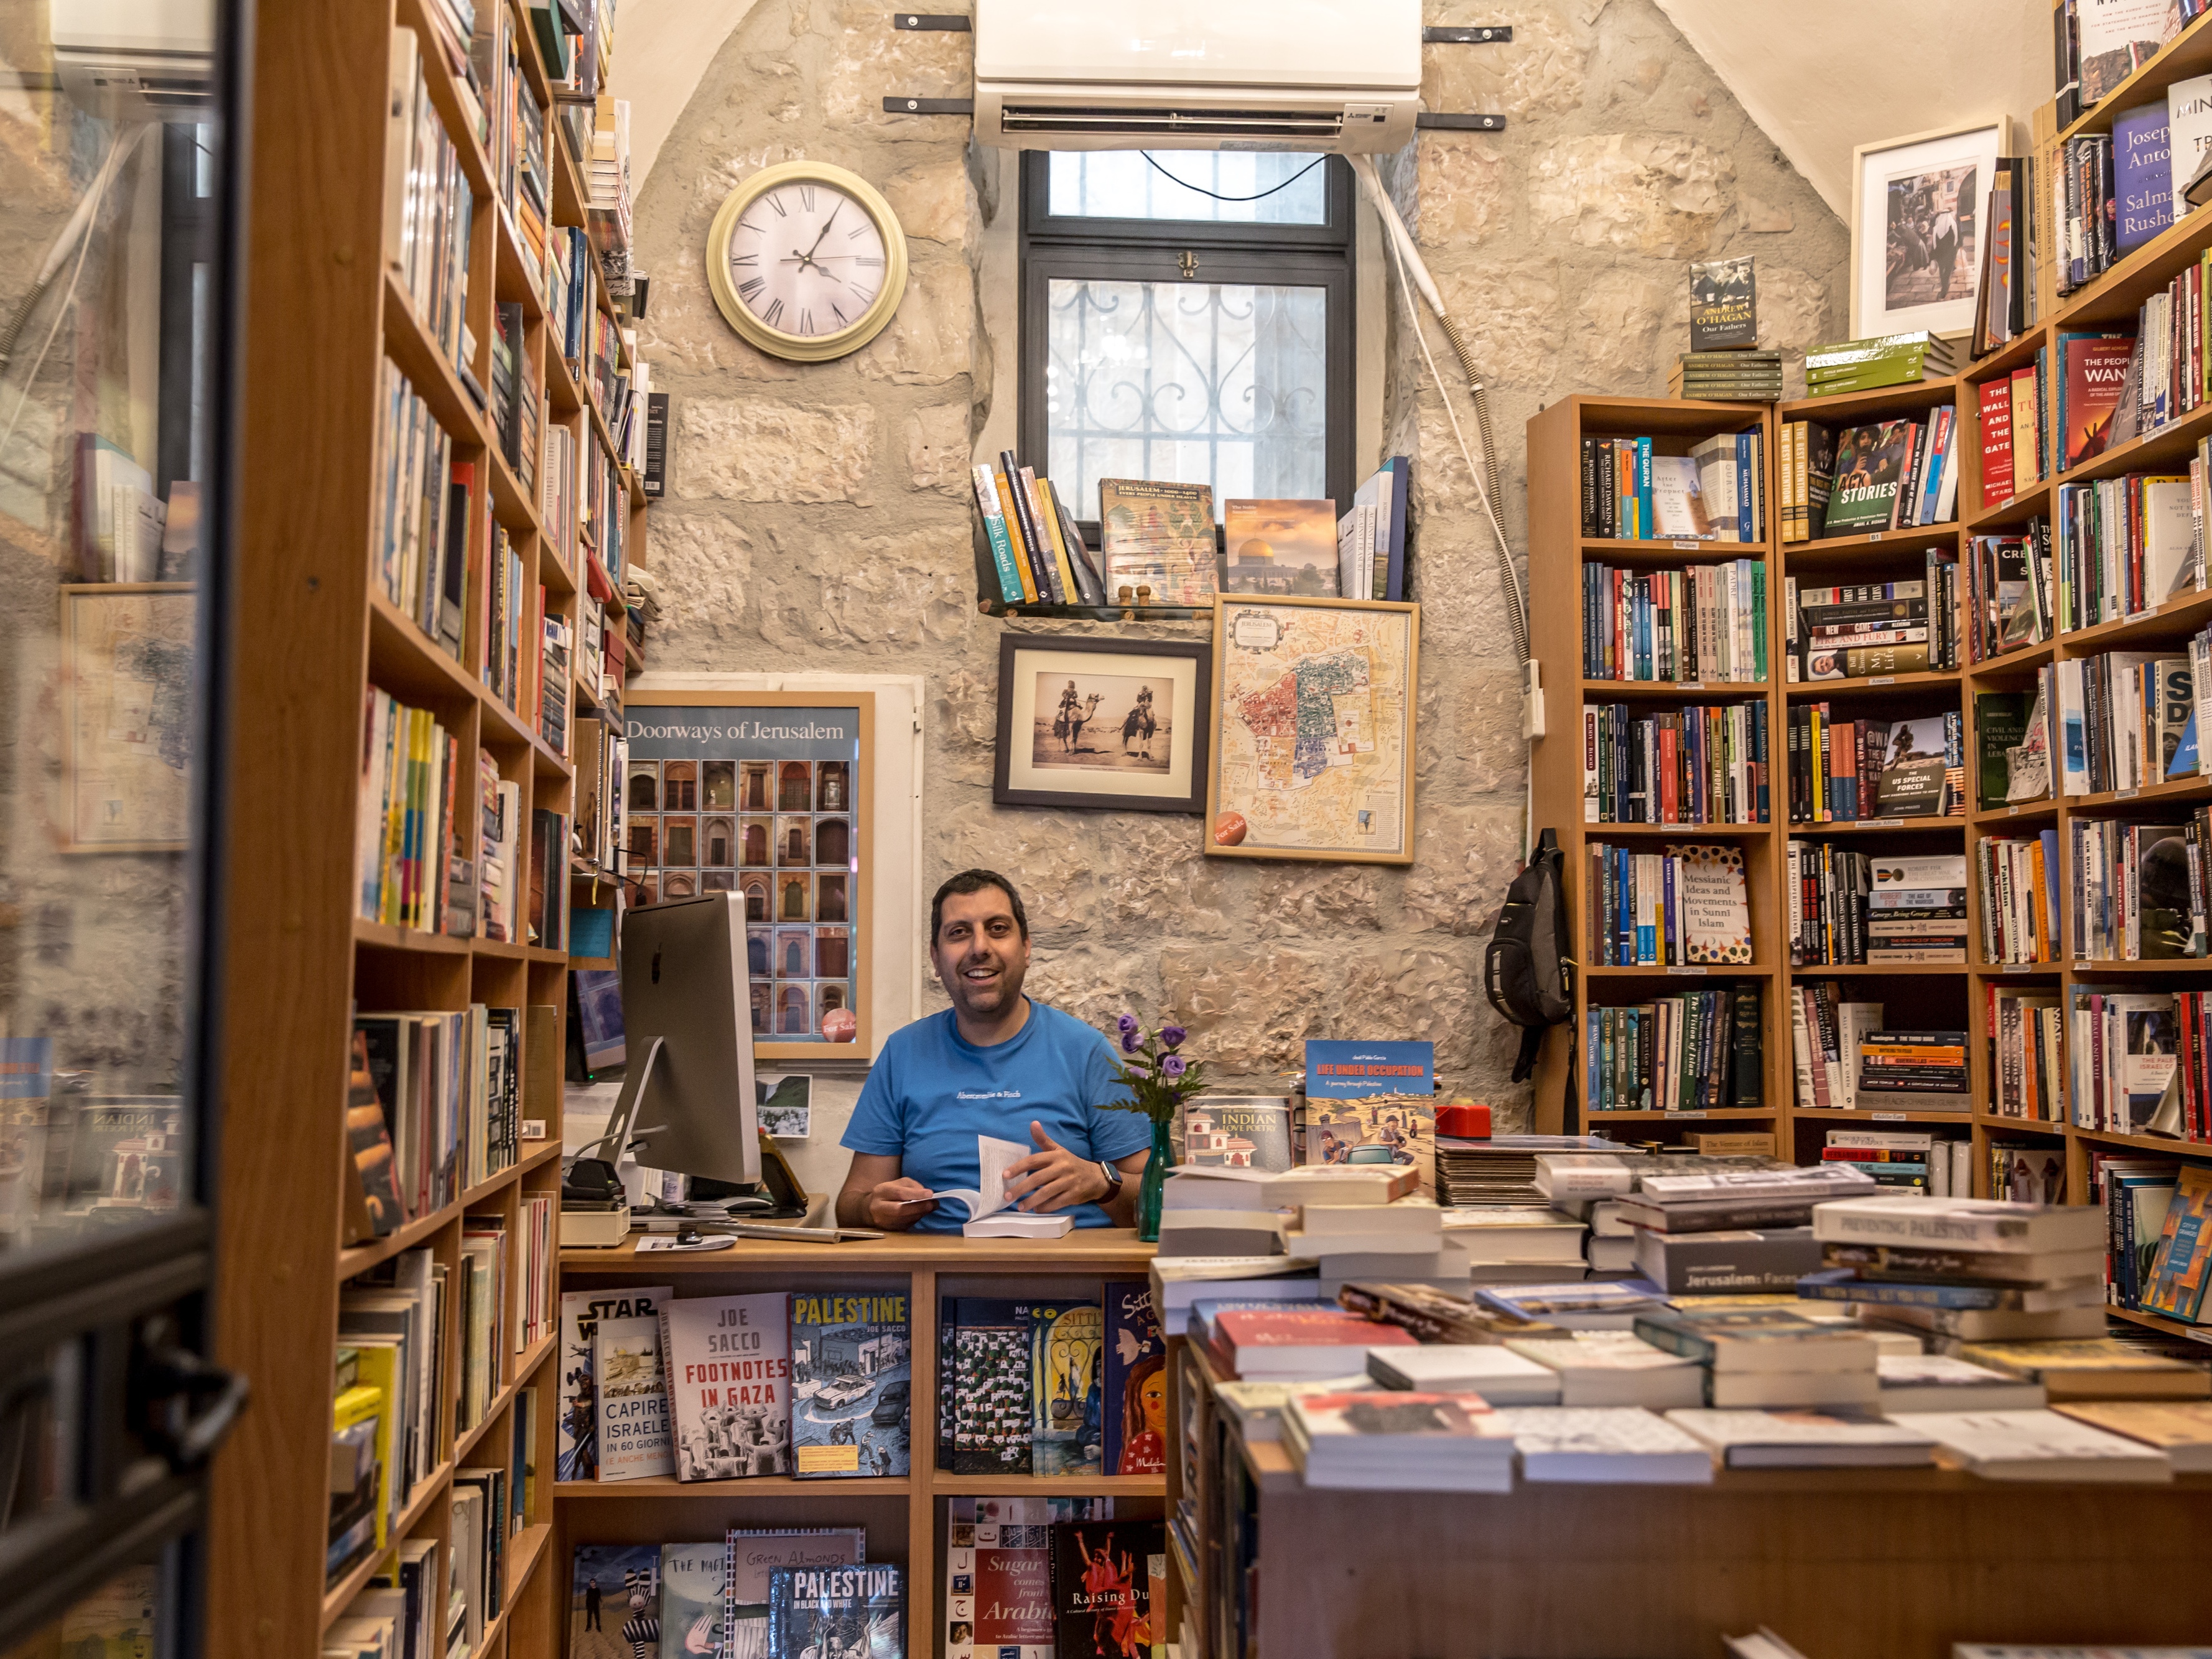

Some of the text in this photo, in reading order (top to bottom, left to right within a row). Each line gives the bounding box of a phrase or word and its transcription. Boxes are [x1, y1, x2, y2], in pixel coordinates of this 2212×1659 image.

[2127, 126, 2171, 152] Josep
[2128, 149, 2171, 170] Anto
[2126, 188, 2173, 213] Salma
[2124, 211, 2175, 235] Rush
[1696, 310, 1752, 326] O'HAGAN
[1703, 304, 1745, 316] ANDREW
[1702, 322, 1747, 333] Our Fathers
[2084, 358, 2103, 366] THE
[2085, 368, 2126, 383] WAN
[1989, 386, 2008, 397] THE
[1982, 401, 2009, 414] WALL
[1988, 414, 2009, 426] AND
[1991, 428, 2010, 439] THE
[1984, 442, 2010, 454] GATE
[1782, 429, 1791, 505] THE BEST INTENTIONS
[1796, 427, 1806, 503] THE BEST INTENTIONS
[1841, 481, 1897, 504] STORIES
[1986, 479, 2012, 490] MICHAEL
[990, 518, 1011, 572] Silk Roads
[1826, 625, 1839, 635] NEW
[1854, 622, 1871, 633] GAME
[1815, 631, 1889, 645] FIRE AND FURY
[1871, 651, 1883, 669] My
[1885, 648, 1894, 669] Life
[626, 720, 844, 744] Doorways of Jerusalem
[1892, 775, 1931, 785] US SPECIAL
[1897, 783, 1924, 791] FORCES
[1214, 819, 1245, 843] For Sale
[1683, 875, 1731, 885] Messianic
[1682, 896, 1737, 906] Movements
[1698, 918, 1724, 928] Islam
[1689, 1014, 1698, 1039] Vision
[1689, 1043, 1697, 1052] of
[1317, 1064, 1424, 1077] LIFE UNDER OCCUPATION
[1688, 1054, 1696, 1076] Islam
[1222, 1113, 1276, 1126] INDIAN
[1222, 1125, 1276, 1133] LOVE POETRY
[1841, 1216, 1978, 1241] PREVENTING PALESTINE
[1686, 1275, 1762, 1288] Jerusalem:
[577, 1298, 658, 1322] STAR
[795, 1296, 906, 1325] PALESTINE
[1121, 1292, 1151, 1320] Sitti
[717, 1308, 748, 1327] JOE
[1062, 1311, 1101, 1326] SITTI'
[708, 1331, 761, 1354] SACCO
[685, 1358, 789, 1385] FOOTNOTES
[701, 1383, 776, 1408] IN GAZA
[606, 1401, 669, 1420] CAPIRE
[606, 1419, 669, 1439] ISRAELE
[606, 1437, 671, 1452] IN 60 GIORNI
[669, 1558, 725, 1574] THE MAGI
[988, 1556, 1043, 1576] Sugar
[794, 1570, 899, 1599] PALESTINE
[1014, 1578, 1045, 1587] comes
[1016, 1588, 1044, 1600] from
[1072, 1589, 1150, 1606] Raising Du
[794, 1601, 800, 1610] IN
[801, 1600, 817, 1609] BLACK
[833, 1599, 852, 1609] WHITE
[983, 1600, 1053, 1620] Arabi
